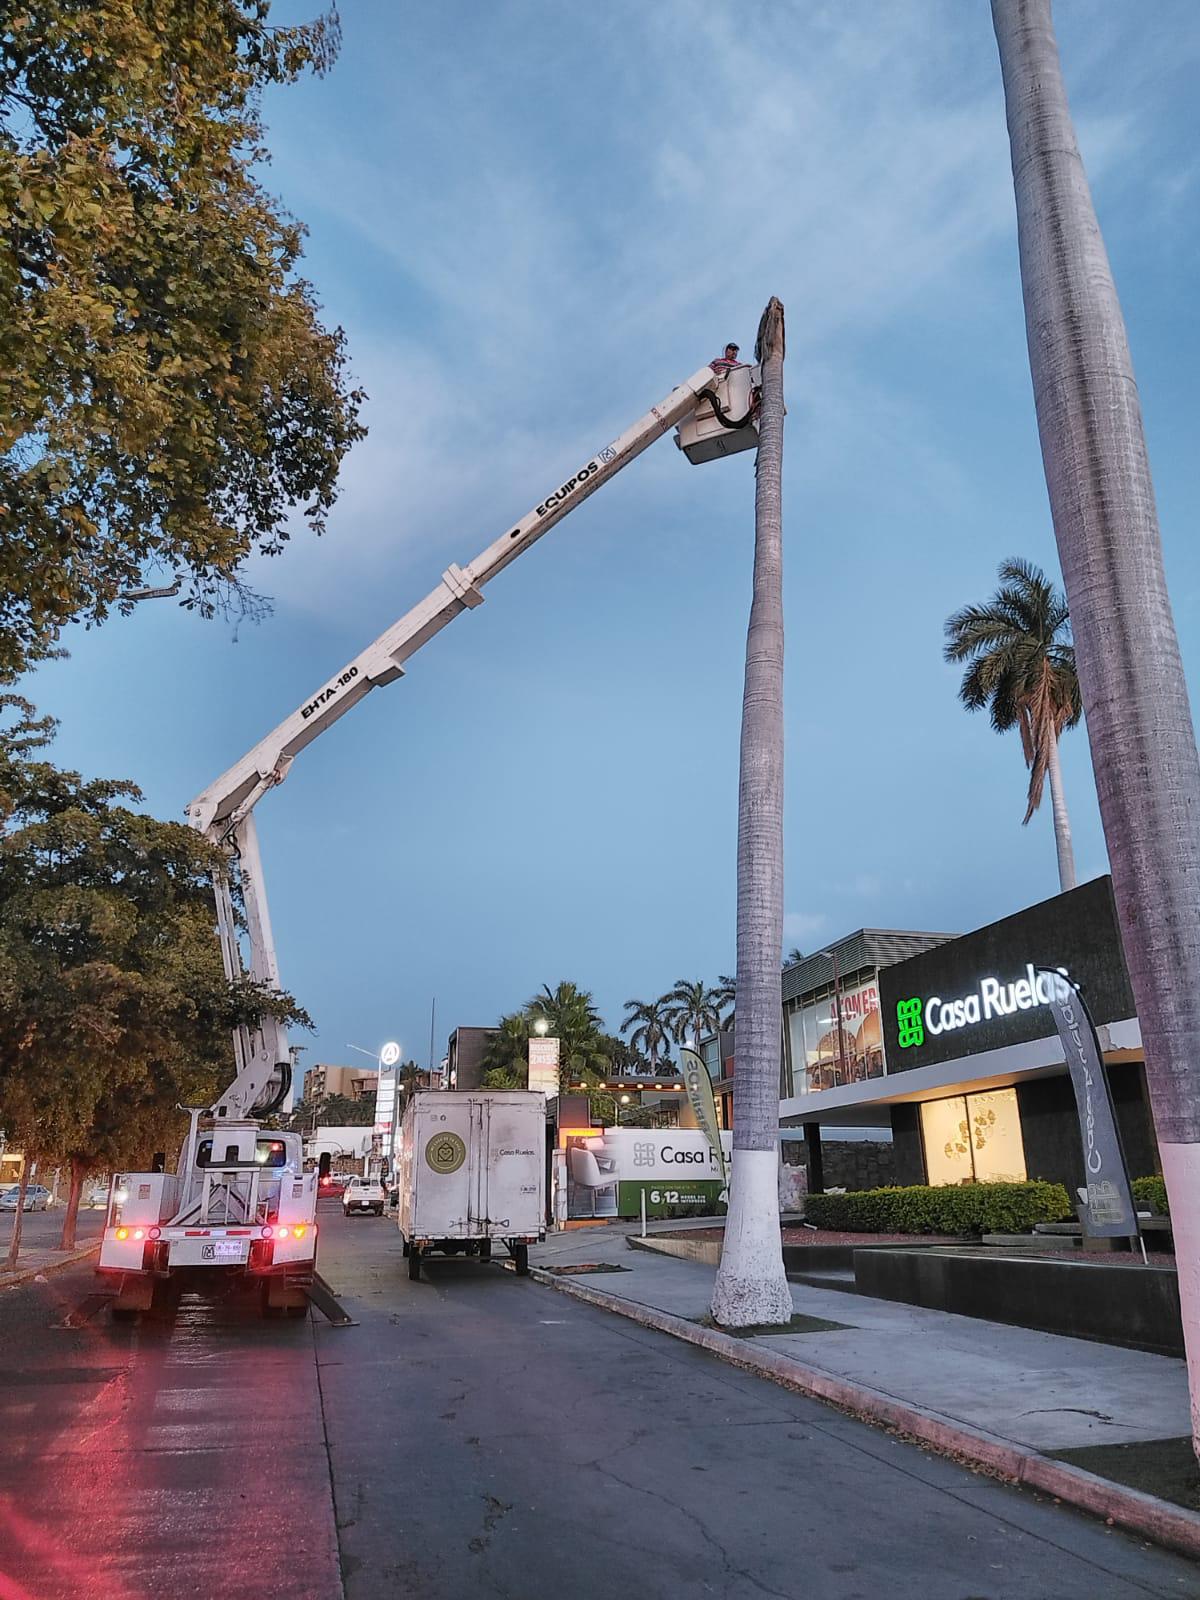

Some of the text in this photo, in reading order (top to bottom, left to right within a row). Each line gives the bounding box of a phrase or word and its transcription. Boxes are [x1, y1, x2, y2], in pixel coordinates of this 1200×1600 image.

[536, 461, 598, 517] EQUIPOS
[301, 666, 358, 719] EHTA-180
[925, 995, 981, 1035] Casa
[661, 1146, 704, 1163] Casa
